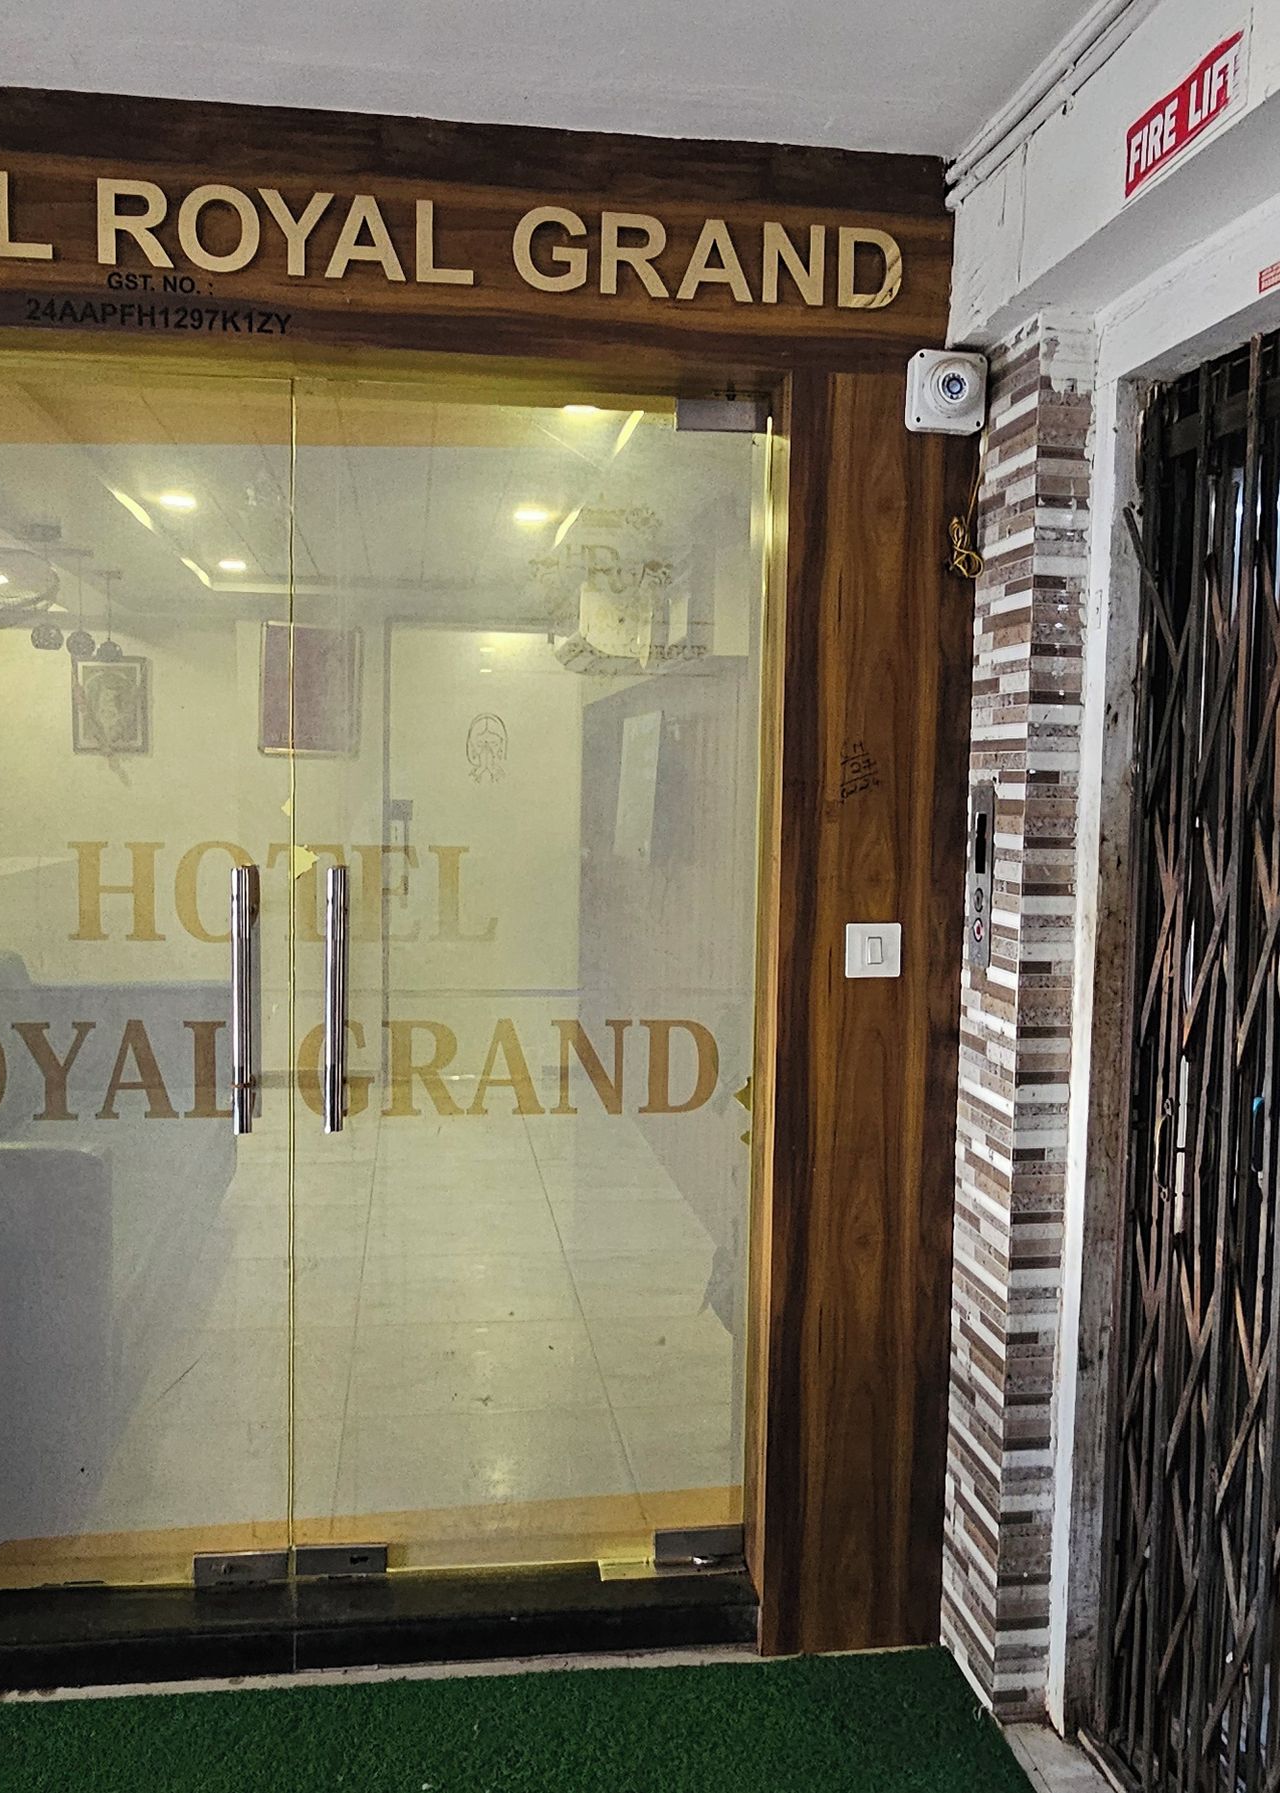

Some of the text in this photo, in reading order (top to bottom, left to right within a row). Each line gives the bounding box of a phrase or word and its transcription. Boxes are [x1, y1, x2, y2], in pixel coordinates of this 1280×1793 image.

[1128, 46, 1241, 183] FIRE LIFT
[97, 177, 474, 287] ROYAL
[513, 205, 903, 309] GRAND
[106, 271, 154, 292] GST.
[25, 298, 292, 335] 24AAPFH1297K1ZY
[66, 840, 499, 943] HOTEL
[297, 1018, 720, 1118] GRAND
